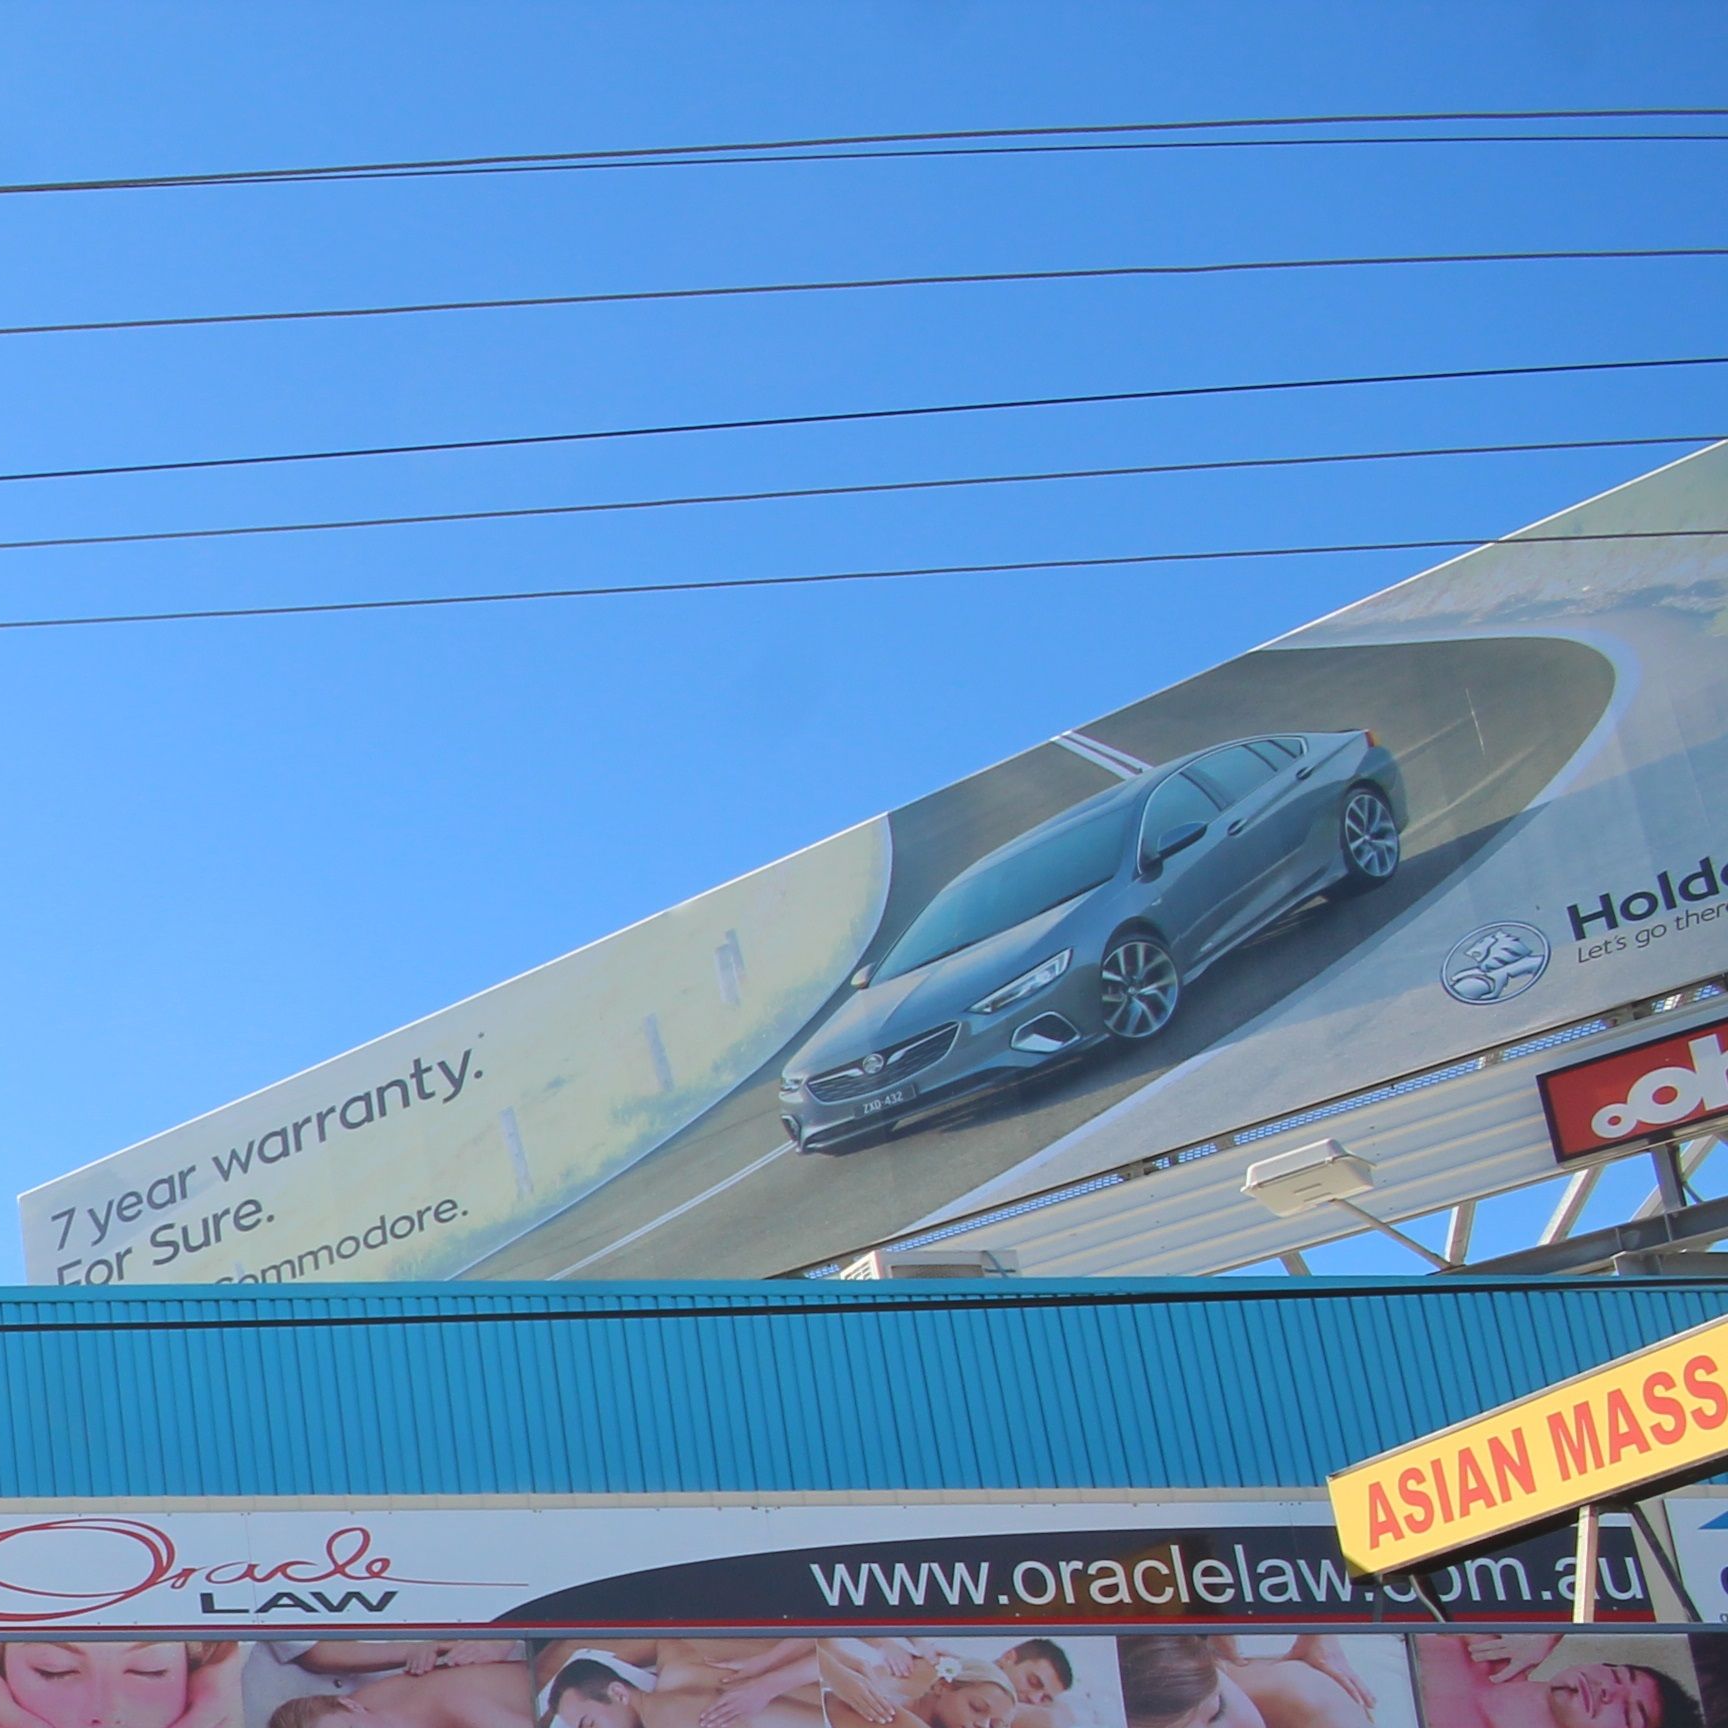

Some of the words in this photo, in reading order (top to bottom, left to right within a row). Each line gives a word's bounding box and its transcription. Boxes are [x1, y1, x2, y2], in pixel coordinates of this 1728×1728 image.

[1566, 856, 1728, 941] Hold
[1578, 935, 1627, 964] Let's
[1635, 924, 1668, 949] go
[1674, 902, 1728, 931] ther
[50, 1206, 76, 1251] 7
[87, 1164, 197, 1246] year
[212, 1048, 485, 1183] warranty.
[56, 1246, 135, 1285] For
[149, 1198, 276, 1266] Sure.
[214, 1197, 470, 1285] mmodore.
[1367, 1427, 1537, 1550] ASIAN
[200, 1590, 399, 1614] LAW
